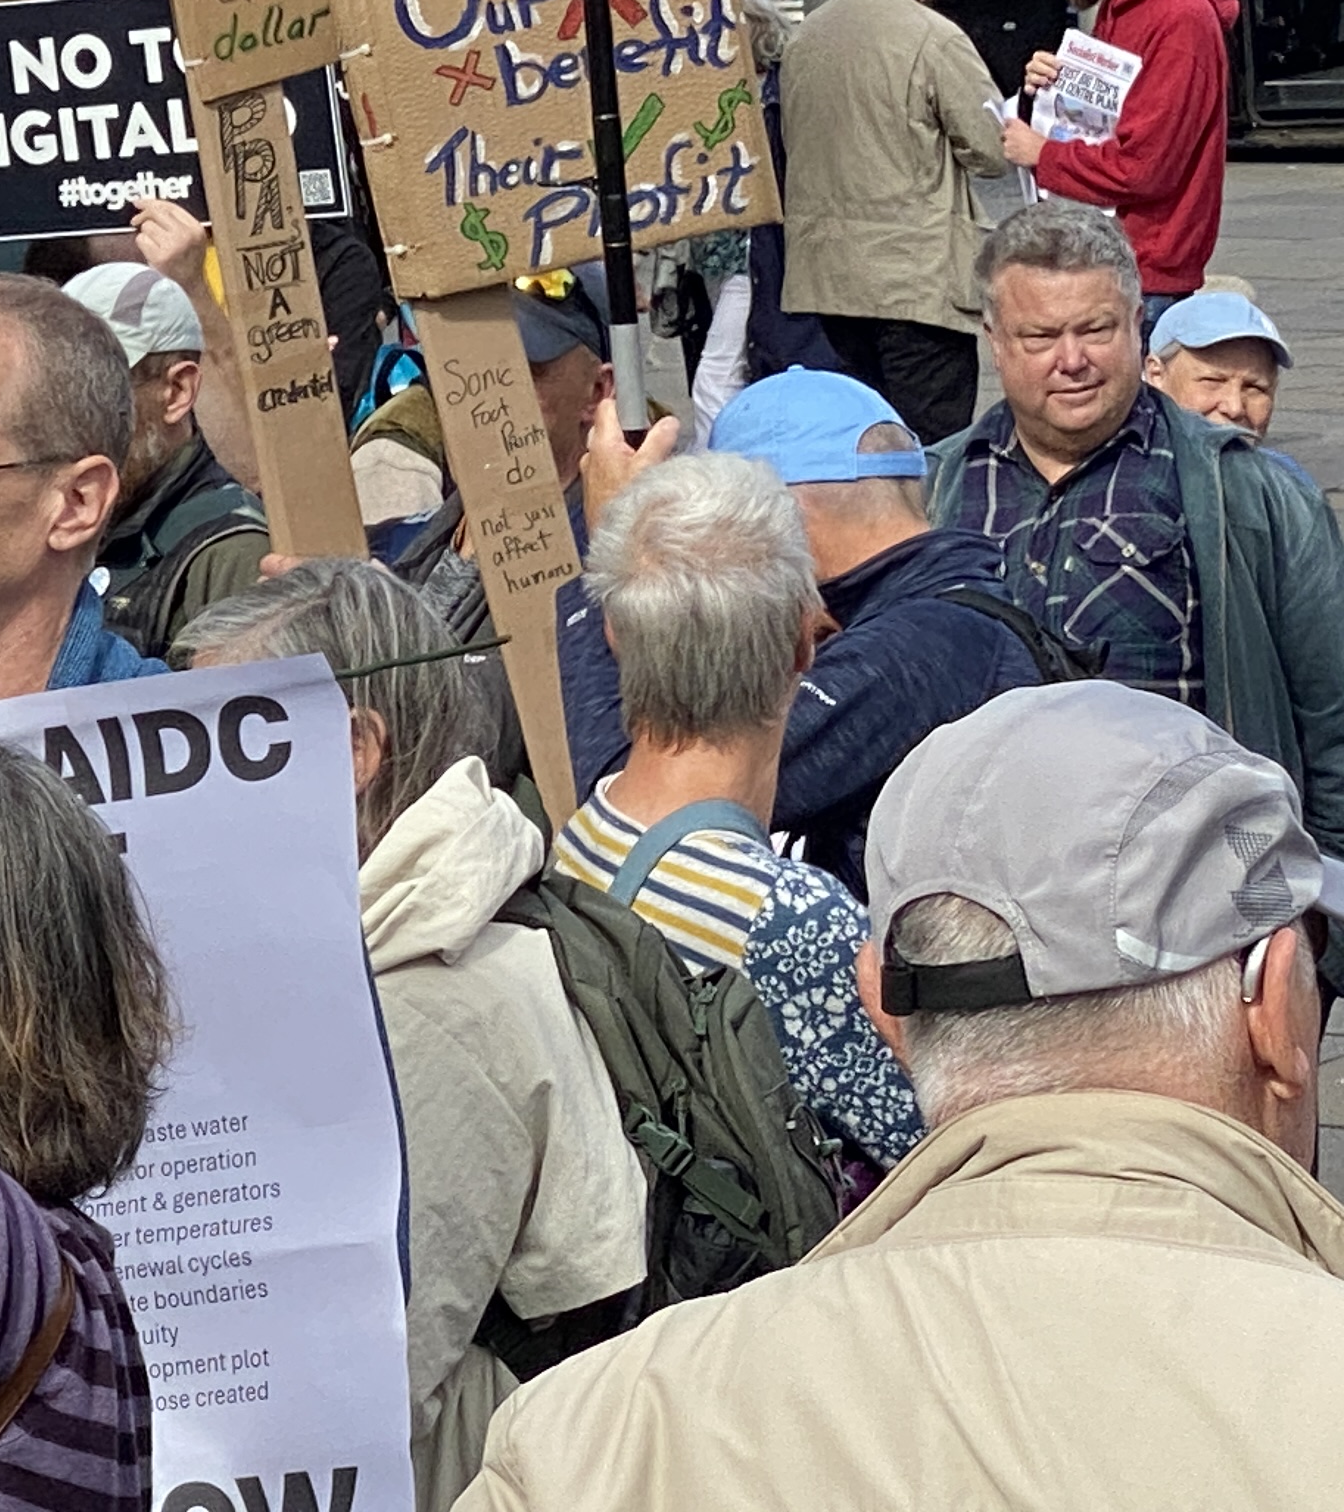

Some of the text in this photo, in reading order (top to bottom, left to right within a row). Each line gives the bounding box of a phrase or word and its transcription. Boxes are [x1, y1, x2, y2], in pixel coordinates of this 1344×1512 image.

[214, 4, 331, 64] dollar
[9, 32, 113, 95] NO
[424, 125, 583, 206] Their
[58, 171, 193, 211] #together
[523, 131, 758, 269] Pofit
[242, 243, 304, 288] NOT
[269, 289, 291, 319] A
[247, 318, 320, 363] green
[444, 359, 514, 406] Sonic
[506, 457, 535, 486] do
[481, 508, 512, 536] not
[492, 530, 553, 567] affect
[44, 694, 292, 807] AIDC
[192, 1114, 248, 1139] water
[160, 1150, 257, 1182] operation
[152, 1191, 168, 1211] &
[172, 1179, 282, 1214] generators
[135, 1213, 274, 1247] temperatures
[187, 1247, 253, 1278] cycles
[153, 1278, 269, 1311] boundaries
[230, 1348, 271, 1378] plot
[194, 1380, 270, 1409] created
